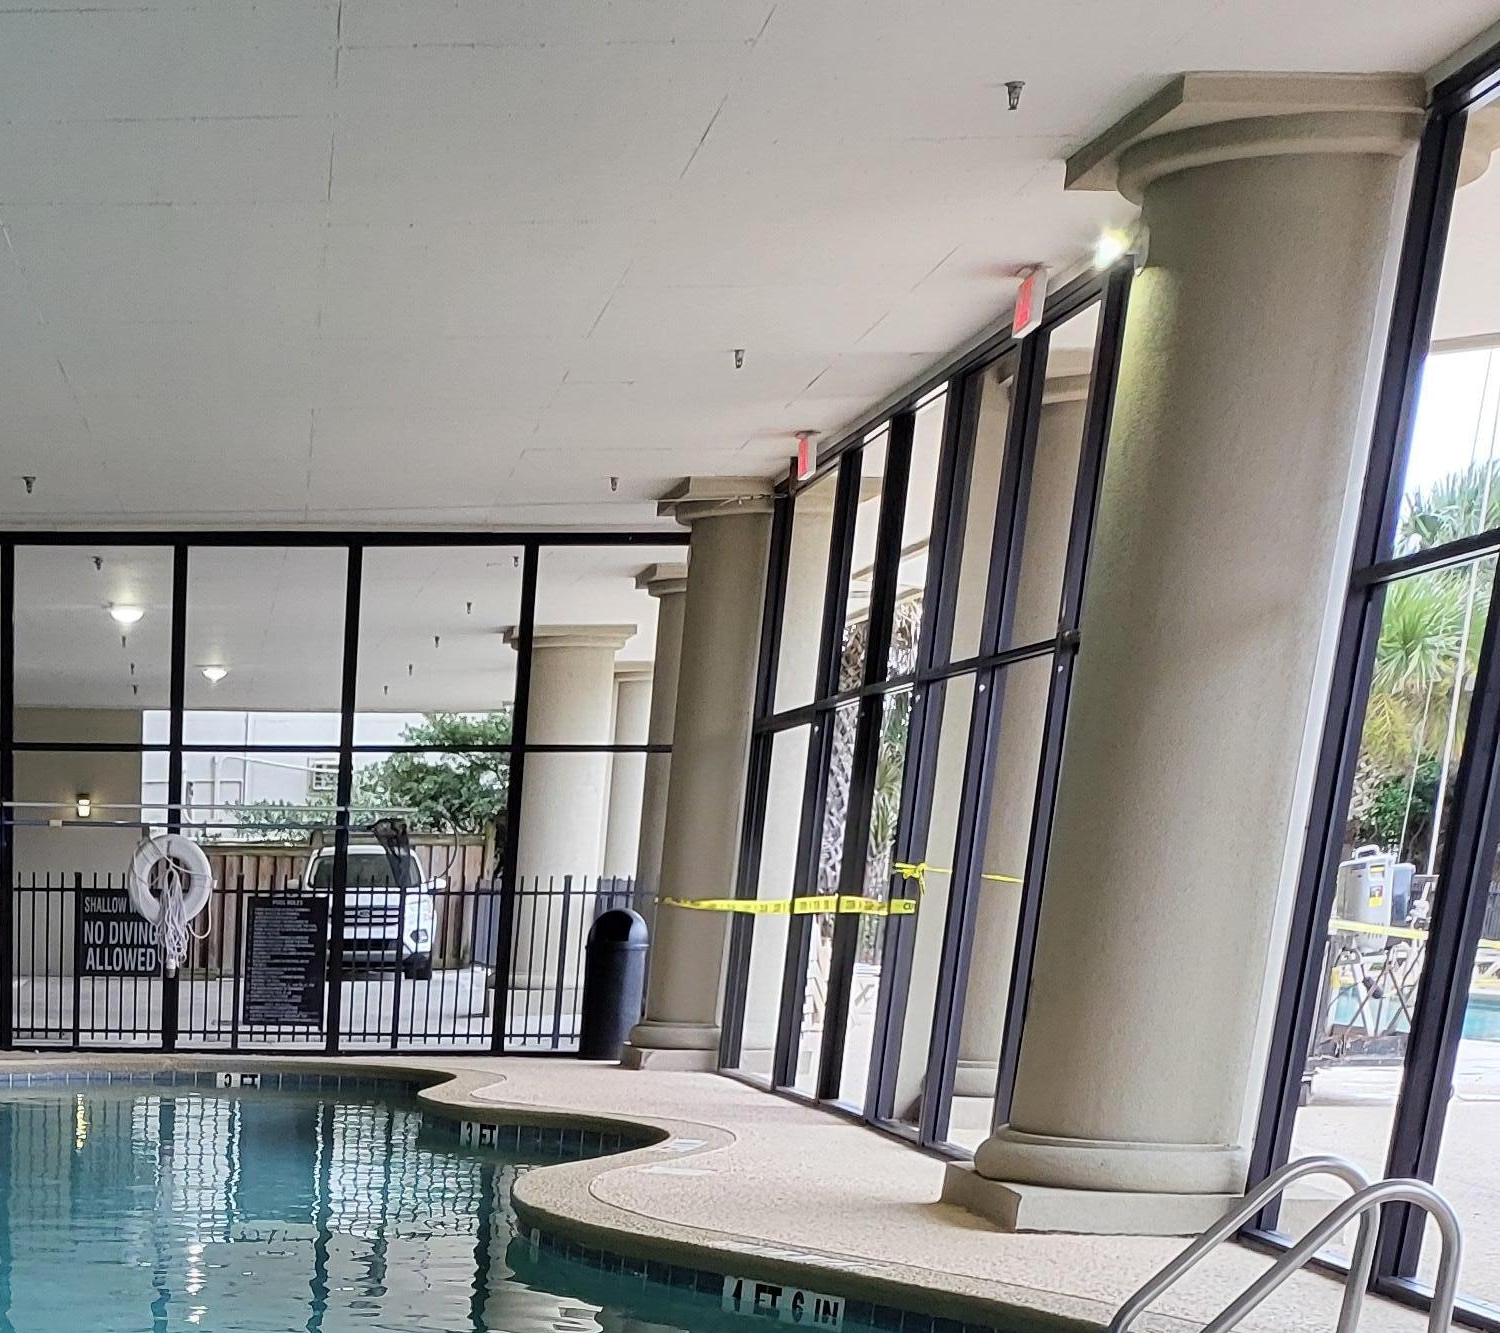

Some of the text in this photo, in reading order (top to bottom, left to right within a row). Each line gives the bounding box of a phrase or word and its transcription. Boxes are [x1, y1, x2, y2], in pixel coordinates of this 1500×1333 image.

[84, 897, 127, 913] SHALLOW
[84, 920, 158, 946] NO DIVING
[86, 947, 156, 972] ALLOWED
[813, 1298, 840, 1326] IN
